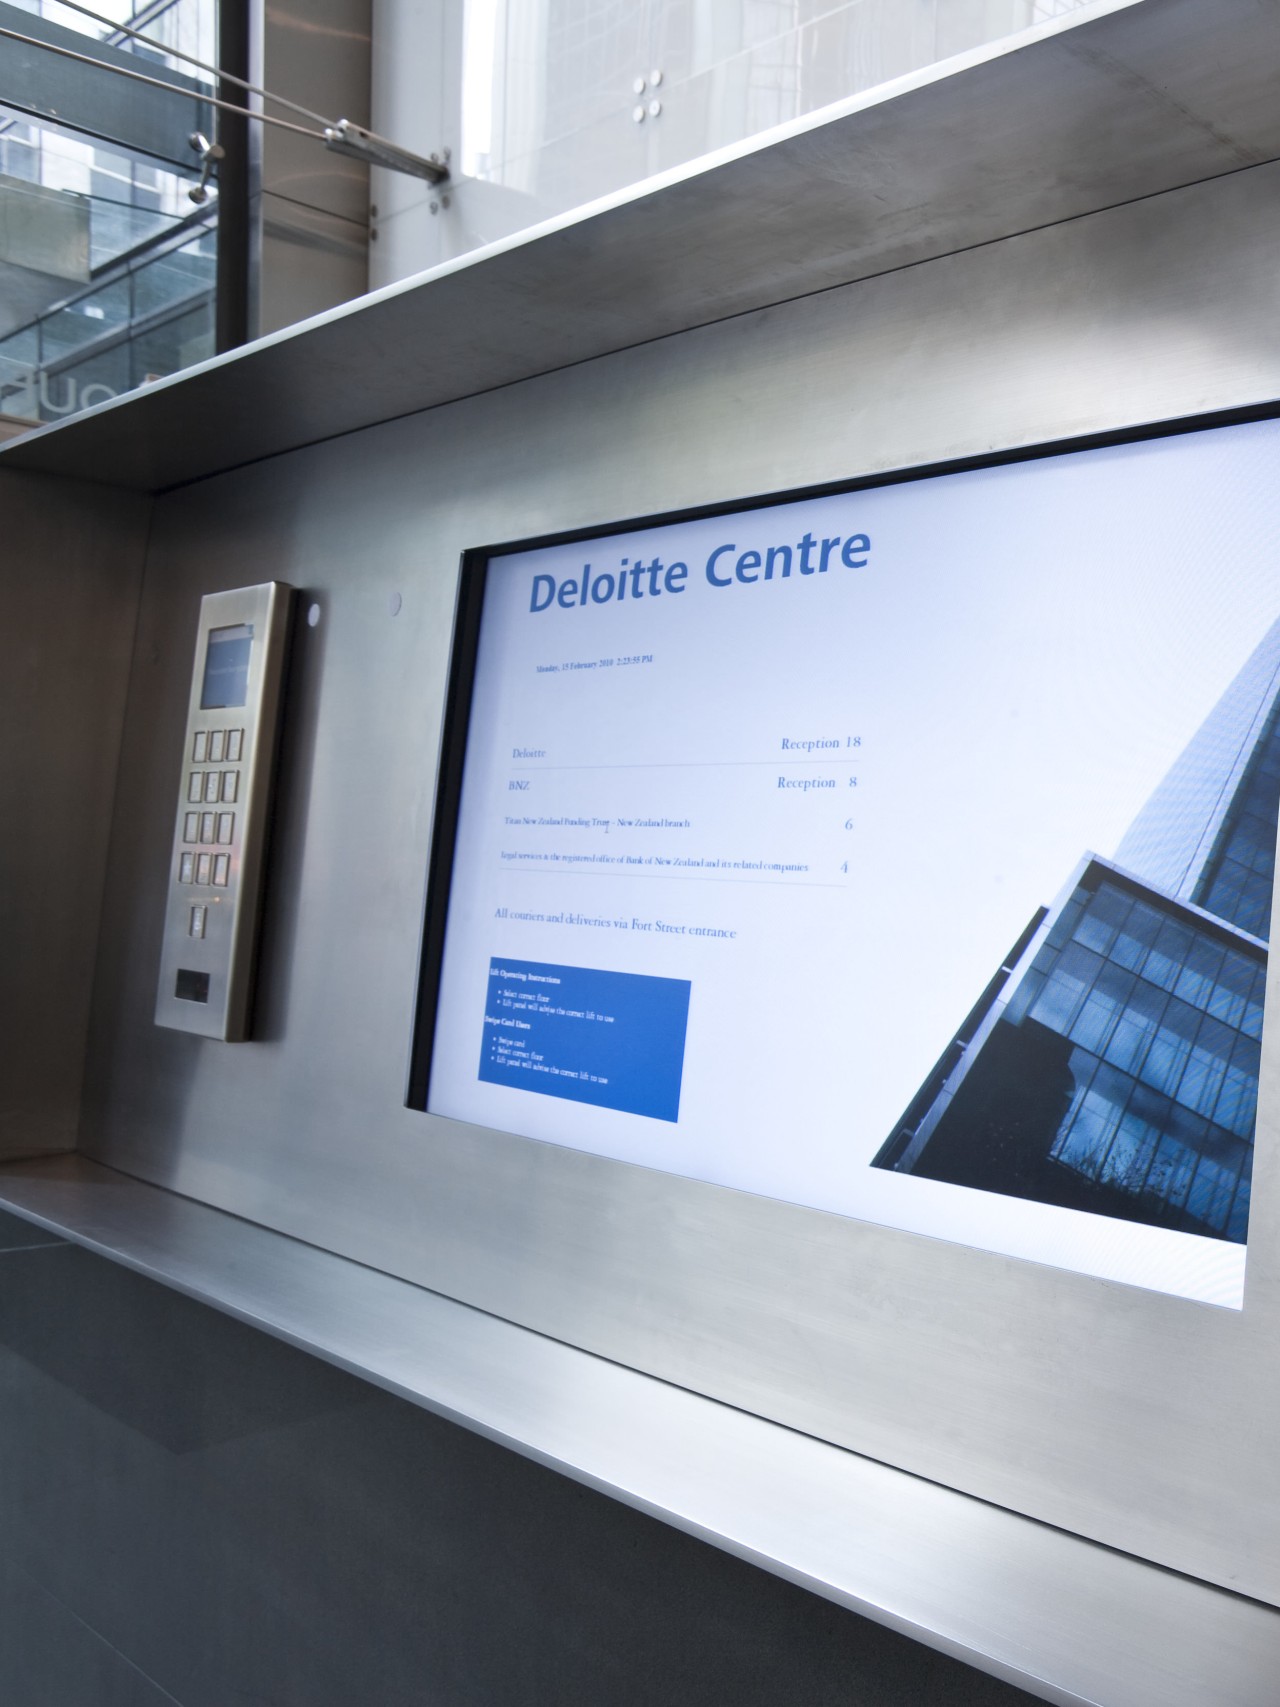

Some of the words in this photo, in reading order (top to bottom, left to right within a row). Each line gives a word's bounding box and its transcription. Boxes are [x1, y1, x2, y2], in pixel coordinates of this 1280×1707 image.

[529, 557, 688, 613] Deloitte
[705, 532, 871, 587] Centre
[570, 662, 597, 670] February
[641, 655, 653, 663] PM
[512, 748, 546, 758] Deloitte
[781, 737, 840, 752] Reception
[846, 736, 861, 748] 18
[508, 780, 530, 791] BNZ
[777, 776, 836, 791] Reception
[849, 776, 857, 787] 8
[523, 817, 536, 825] New
[538, 817, 563, 825] Zealand
[617, 818, 632, 826] New
[634, 818, 663, 827] Zealand
[665, 819, 690, 828] branch
[845, 818, 853, 830] 6
[562, 854, 596, 863] registered
[596, 855, 615, 863] office
[617, 855, 624, 864] of
[626, 856, 643, 864] Bank
[645, 856, 652, 865] of
[654, 857, 671, 865] New
[673, 857, 704, 867] Zealand
[705, 859, 719, 868] and
[721, 860, 731, 868] its
[733, 860, 762, 870] related
[764, 863, 808, 873] companies
[840, 861, 848, 873] 4
[495, 907, 508, 918] All
[510, 909, 545, 921] couriers
[546, 912, 564, 923] and
[565, 913, 611, 927] deliveries
[614, 917, 628, 929] via
[631, 918, 653, 931] Fort
[655, 920, 686, 934] Street
[688, 926, 737, 939] entrance
